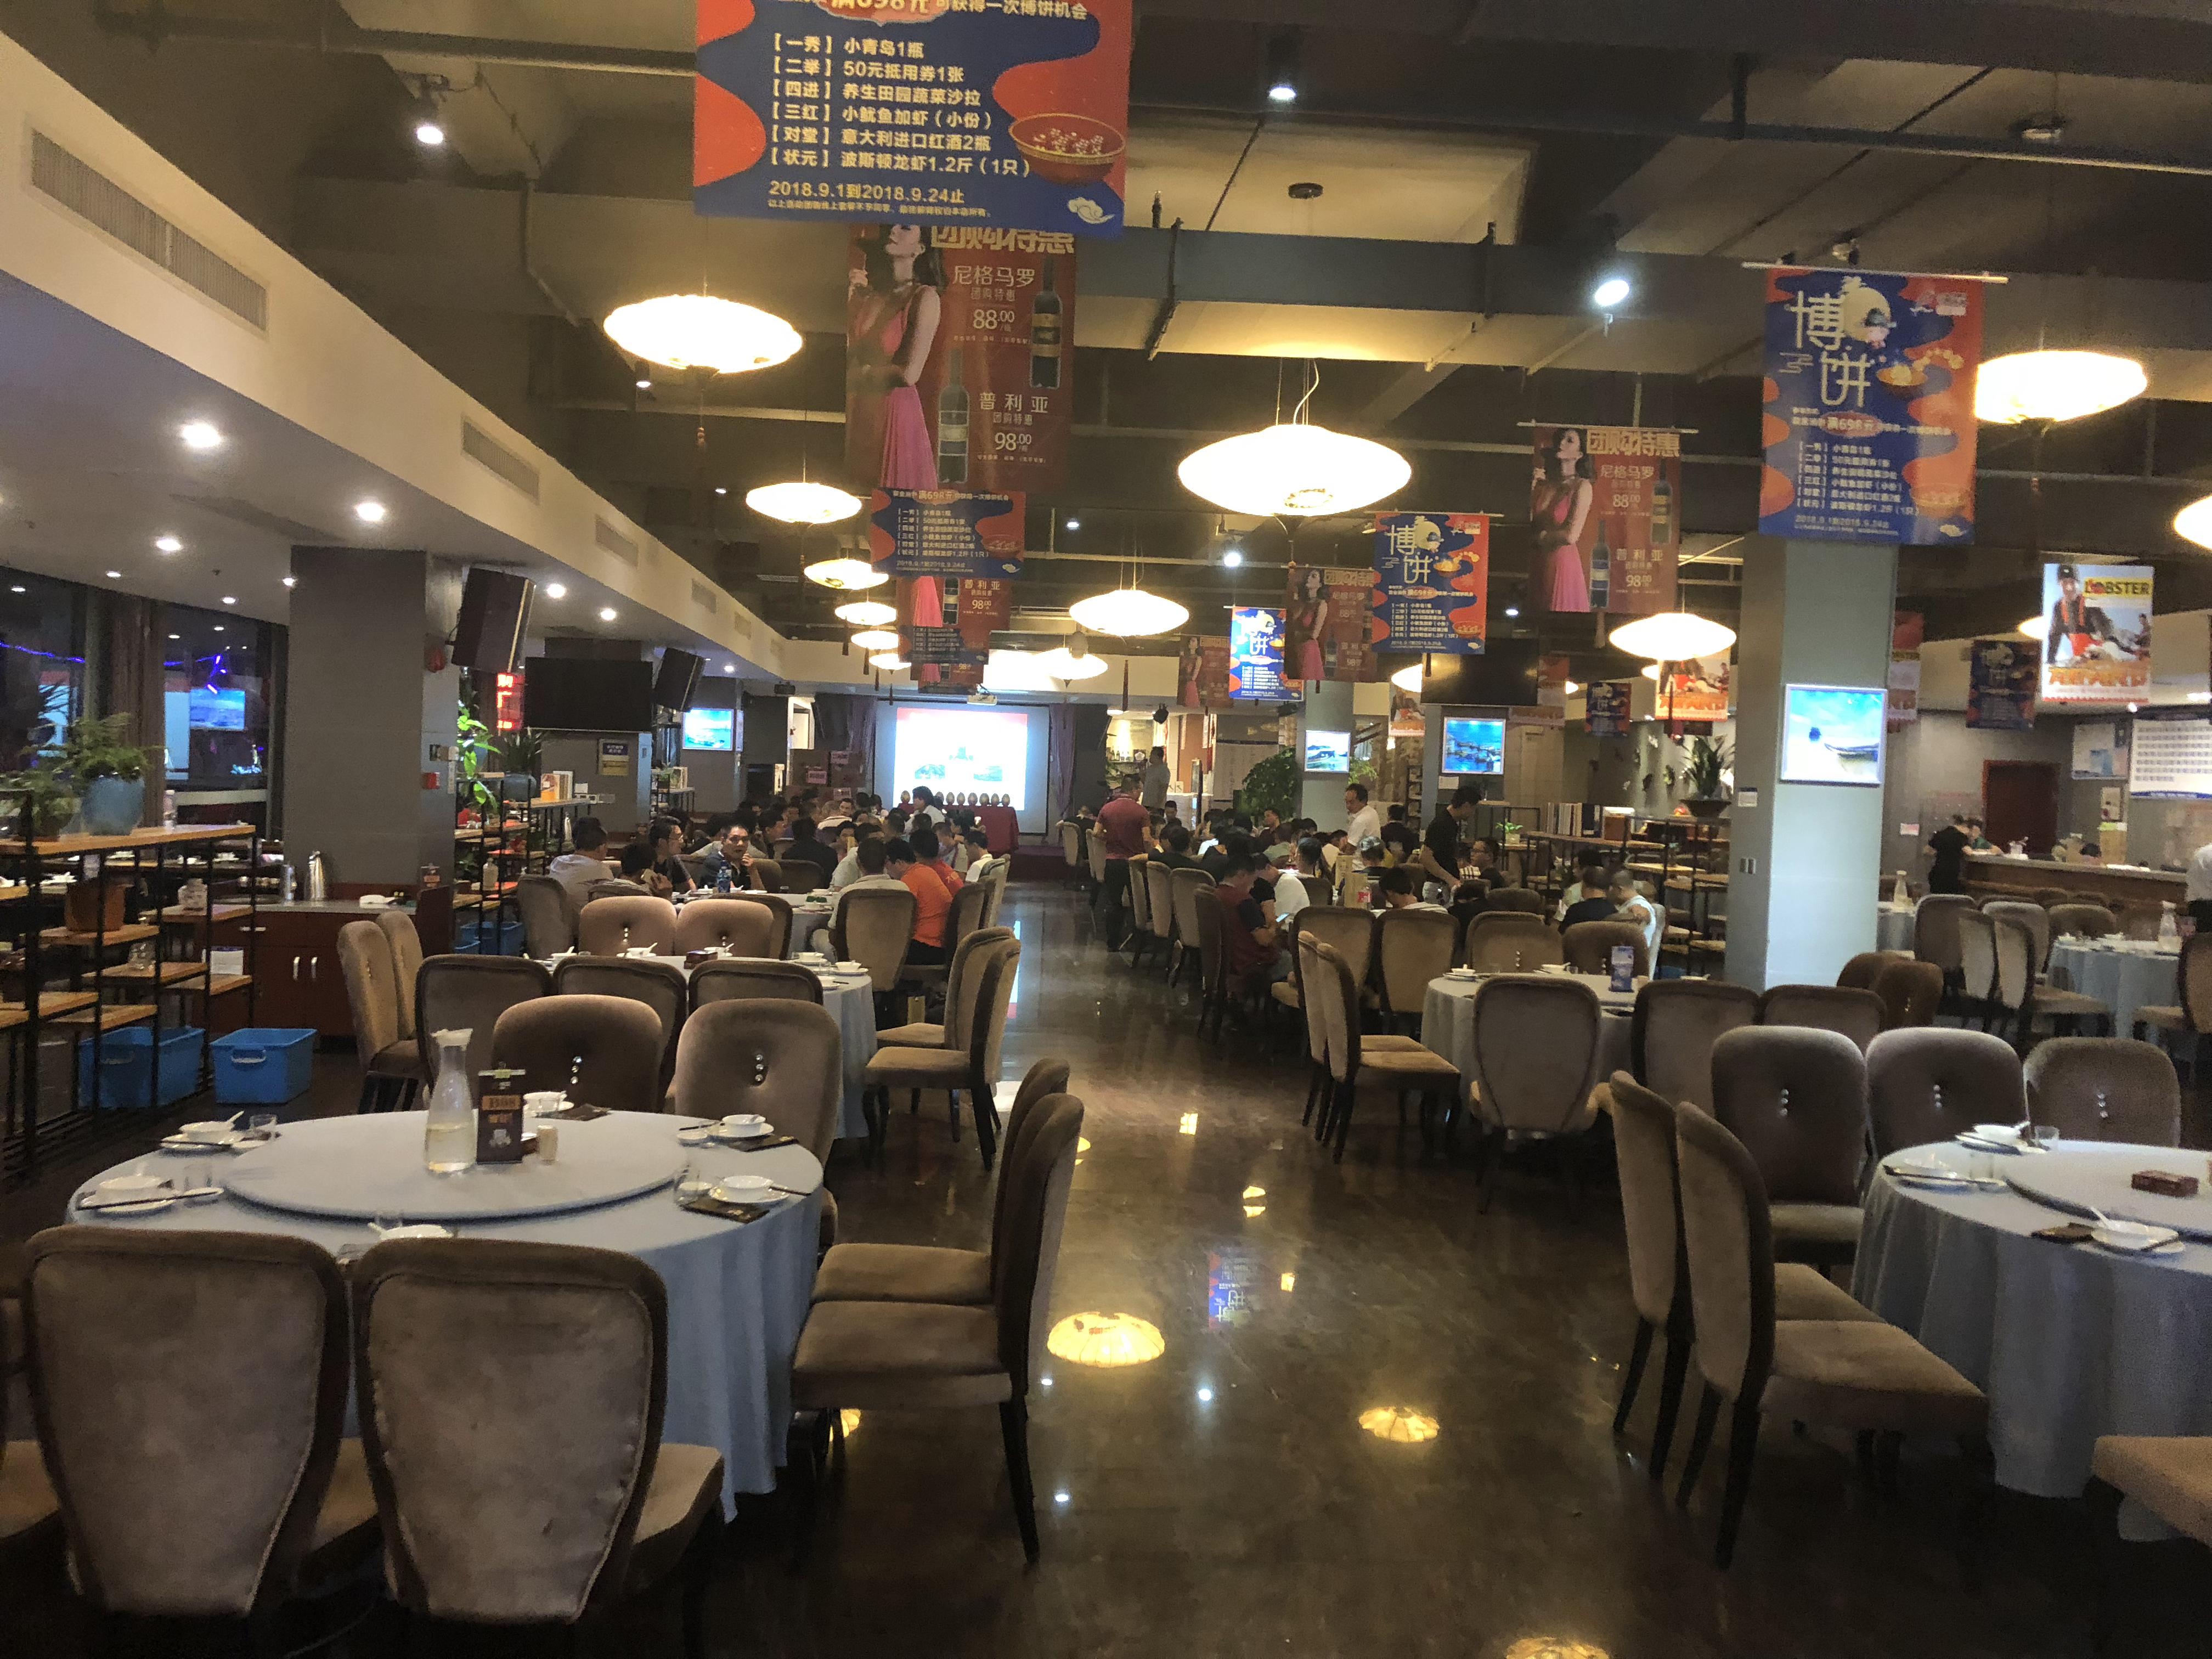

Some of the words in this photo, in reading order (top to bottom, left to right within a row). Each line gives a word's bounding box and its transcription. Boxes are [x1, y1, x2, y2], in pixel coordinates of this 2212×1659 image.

[843, 37, 924, 59] 小青岛1瓶
[843, 60, 964, 82] 50元抵用券1张
[843, 82, 981, 106] 养生田园蔬菜沙拉
[841, 128, 991, 152] 意大利进口红酒2瓶
[769, 179, 965, 204] 2018.9.1到2018.9.24止
[952, 265, 1035, 288] 尼格马罗
[973, 309, 1015, 329] 88.00
[979, 392, 1049, 414] 普利亚
[995, 432, 1032, 451] 98.00
